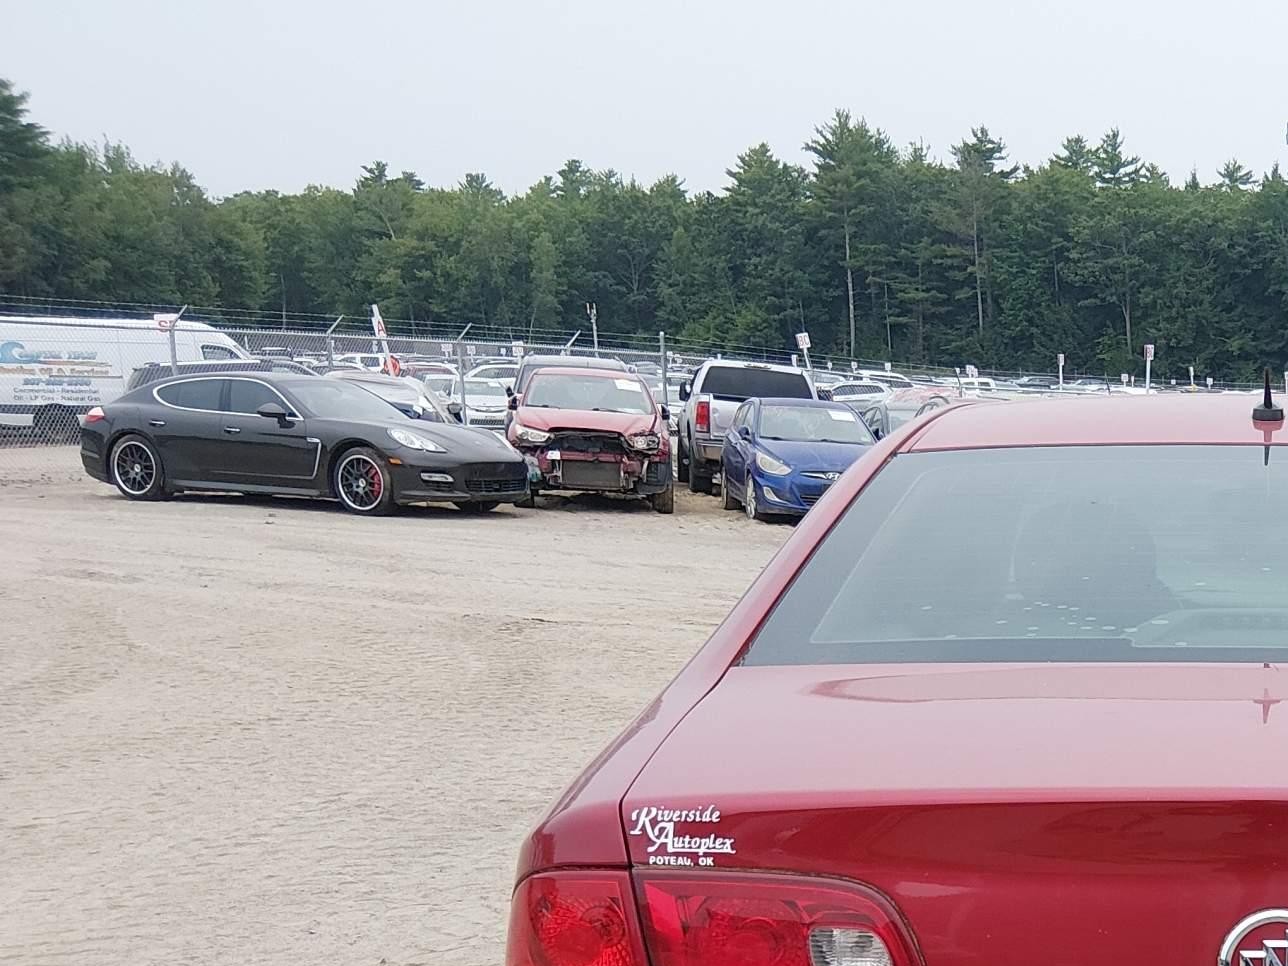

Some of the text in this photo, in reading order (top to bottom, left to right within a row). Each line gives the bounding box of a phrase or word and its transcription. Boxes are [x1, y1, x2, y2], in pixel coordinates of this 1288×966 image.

[799, 335, 810, 346] BC
[630, 804, 721, 835] Riverside
[647, 821, 737, 856] Autoplex
[649, 856, 714, 866] POTEAU, OK
